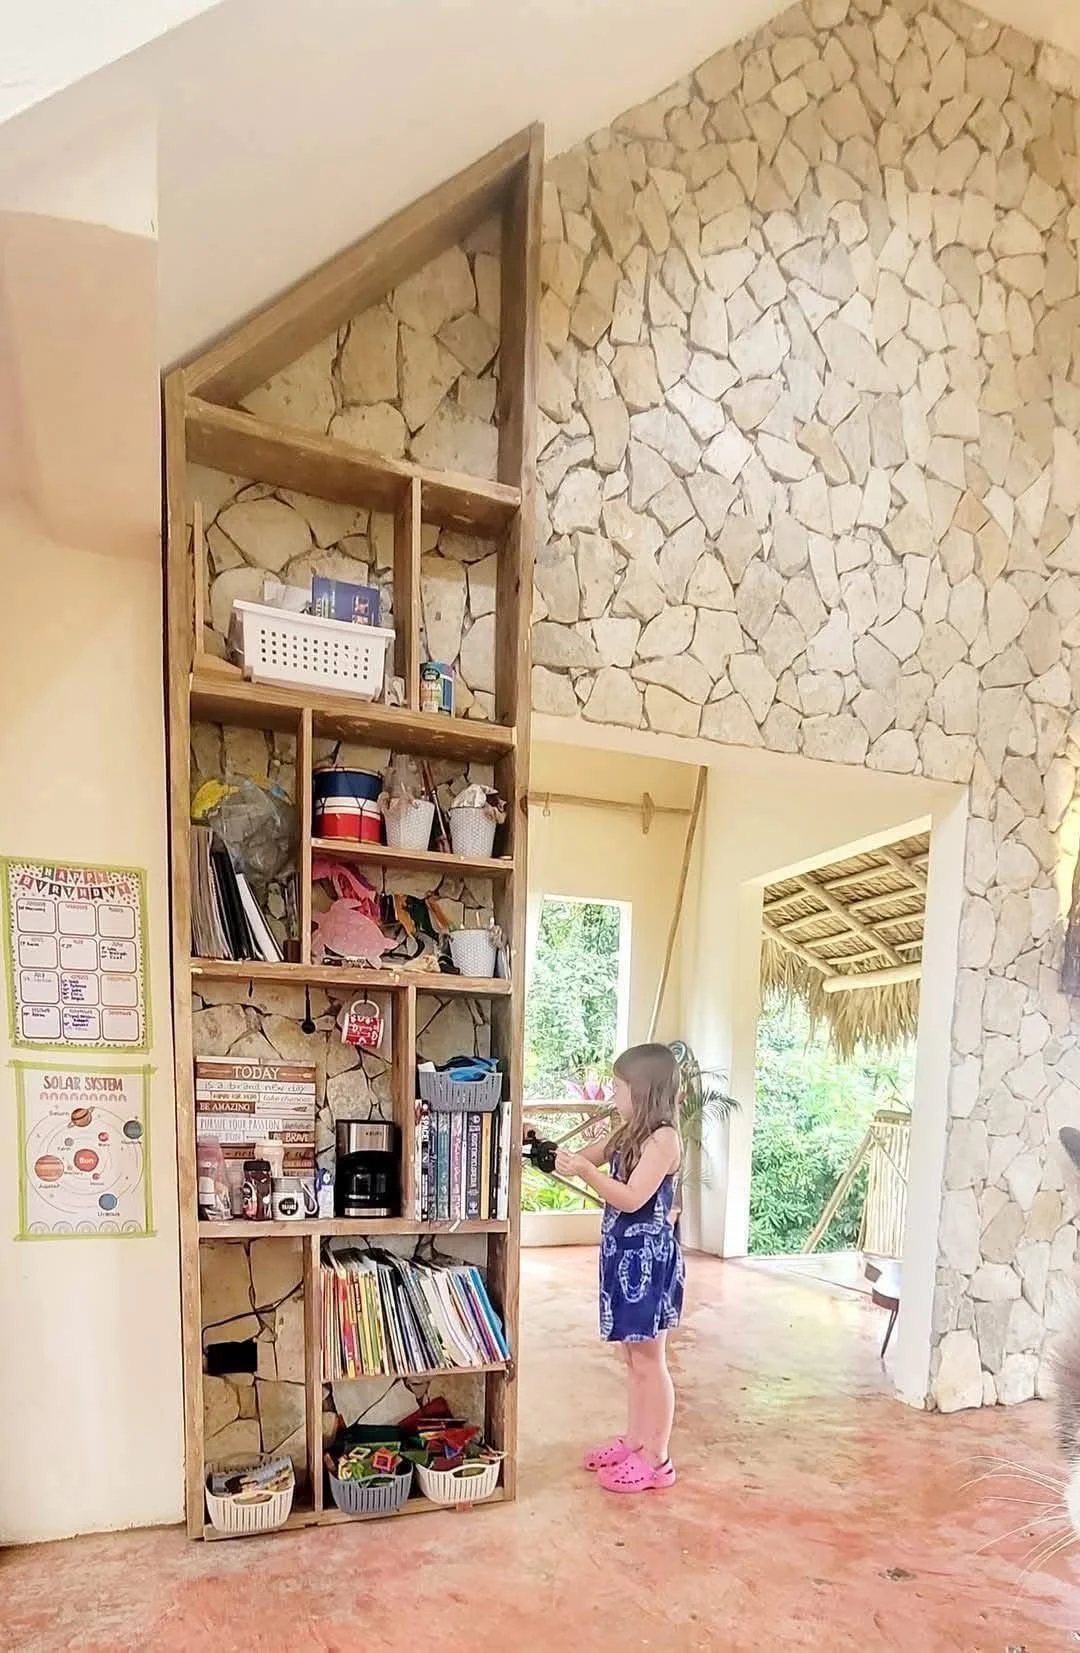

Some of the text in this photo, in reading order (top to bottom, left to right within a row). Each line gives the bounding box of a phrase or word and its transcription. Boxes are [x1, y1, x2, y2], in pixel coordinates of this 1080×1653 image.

[45, 866, 108, 883] HAPPY
[21, 875, 130, 899] BIRTHDAY
[232, 1066, 280, 1080] TODAY
[43, 1075, 123, 1092] SOLAR SYSTEM
[212, 1103, 251, 1111] AMAZING
[200, 1119, 225, 1129] PURSUE
[229, 1119, 247, 1129] YOUR
[248, 1119, 280, 1130] PASSION
[285, 1132, 309, 1142] BRAVE
